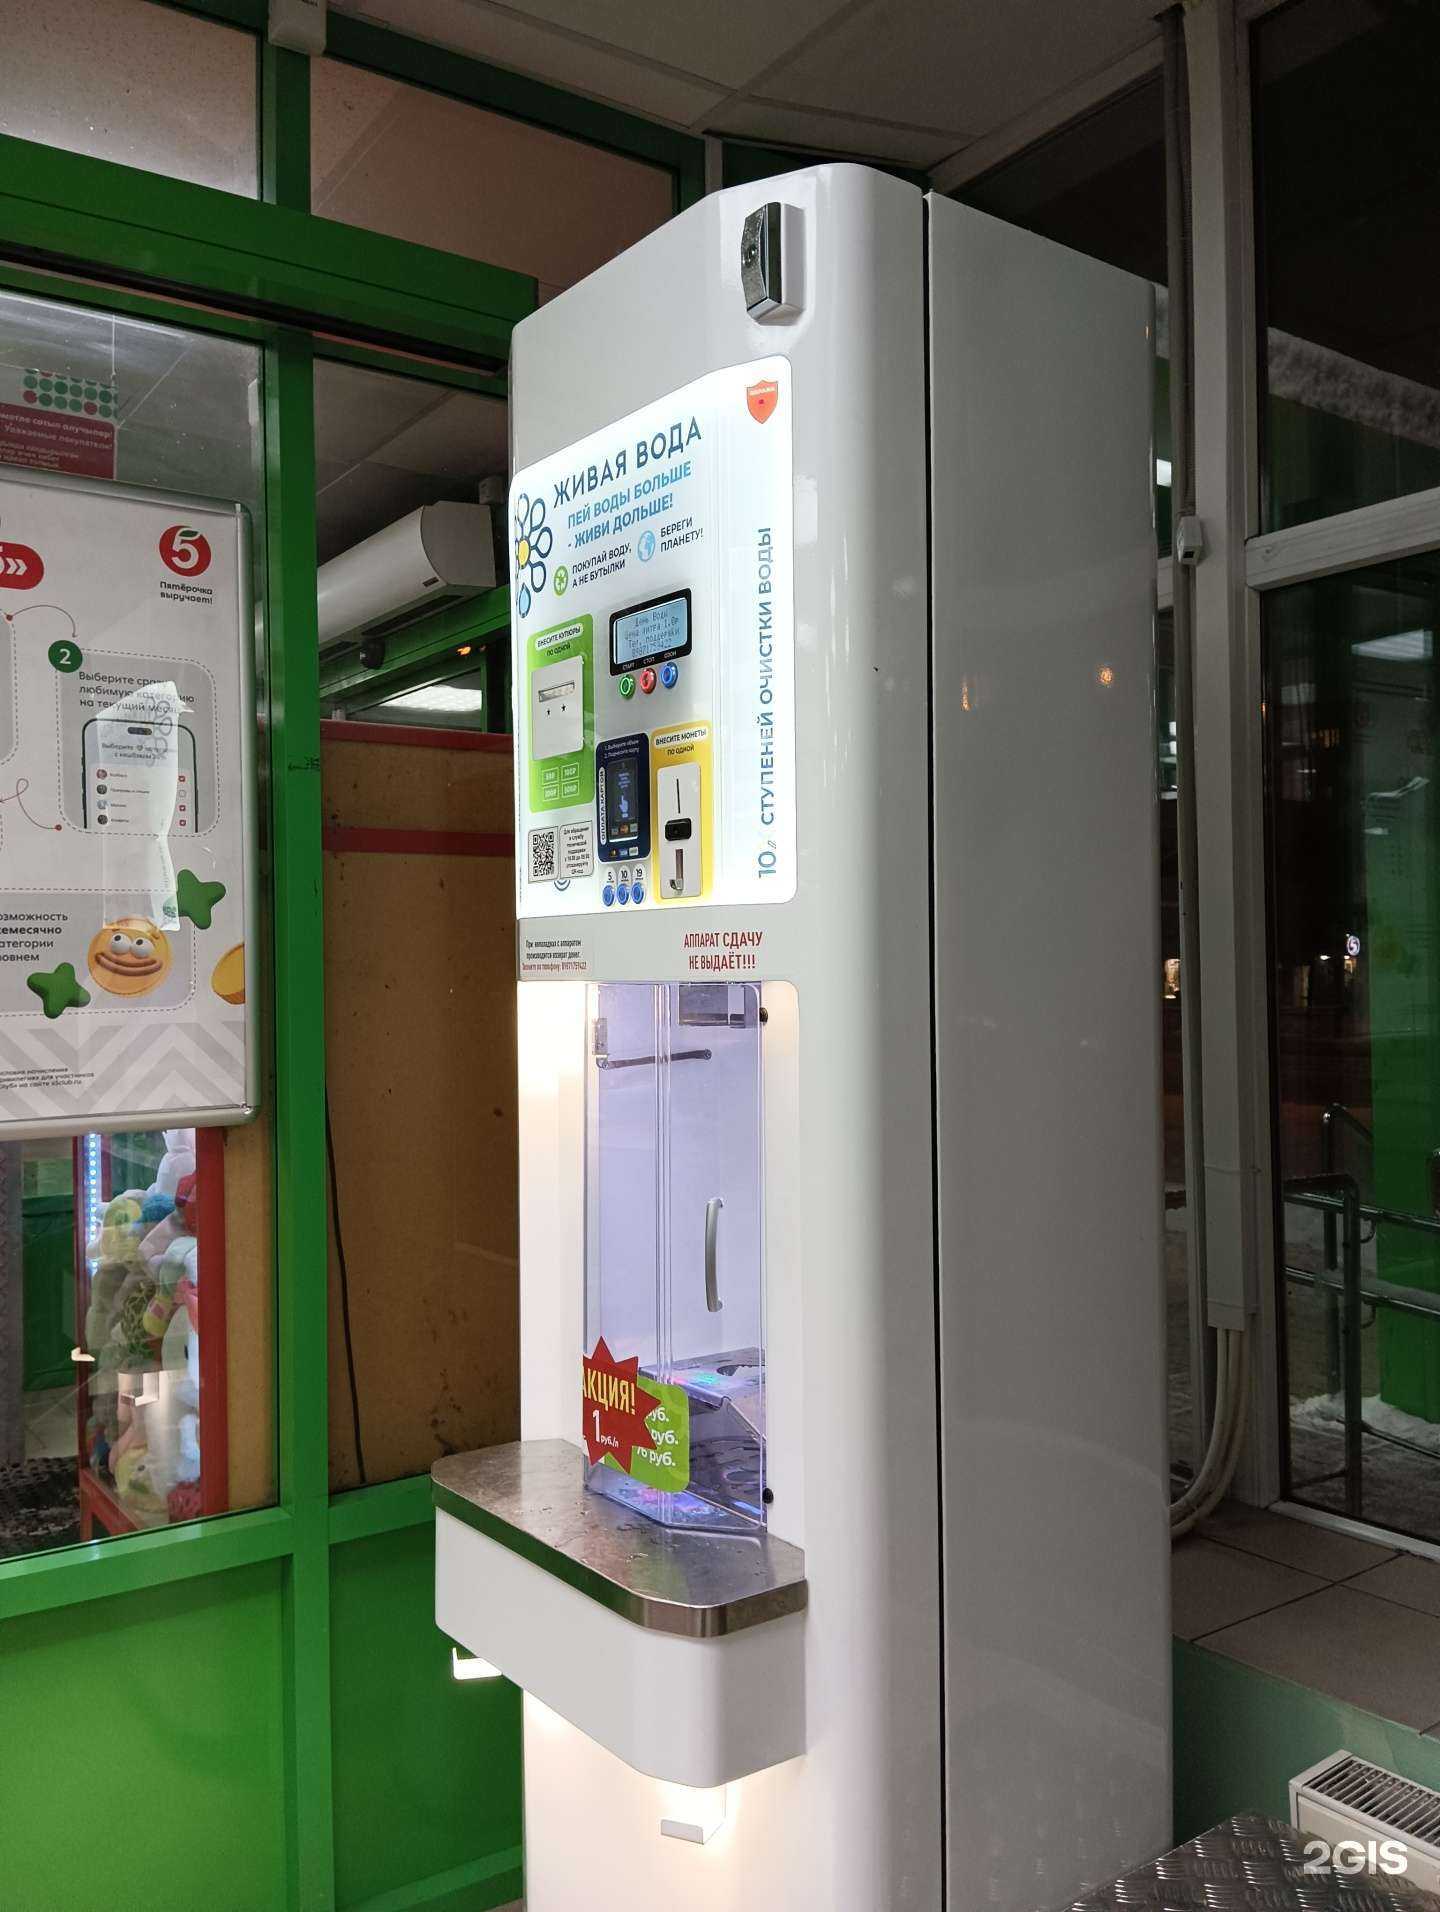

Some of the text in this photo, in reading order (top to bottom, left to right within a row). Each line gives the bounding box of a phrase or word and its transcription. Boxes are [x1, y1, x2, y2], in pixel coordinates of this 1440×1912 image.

[553, 415, 702, 508] ЖИВАЯ ВОДА
[568, 460, 691, 529] ПЕЙ ВОДЫ БОЛЬШЕ
[574, 520, 609, 548] ЖИВИ
[612, 493, 673, 535] ДОЛЬШЕ!
[660, 516, 693, 538] БЕРЕГИ
[660, 527, 704, 552] ПЛАНЕТУ!
[572, 542, 632, 575] ПОКУПАЙ ВОДУ,
[758, 527, 773, 594] ВОДЫ
[572, 558, 625, 588] А НЕ БУТЫЛКИ
[160, 581, 213, 595] Пятёрочка
[160, 591, 213, 605] выручает!
[58, 648, 72, 665] 2
[759, 601, 773, 704] ОЧИСТКИ
[79, 672, 135, 685] Выберите
[80, 699, 94, 707] на
[656, 728, 706, 745] ВНЕСИТЕ МОНЕТЫ
[667, 748, 675, 756] ПО
[757, 711, 774, 825] СТУПЕНЕЙ
[607, 871, 613, 881] 5
[620, 870, 628, 879] 10
[635, 868, 643, 877] 19
[0, 926, 62, 935] емесячно
[0, 940, 54, 949] атегории
[684, 931, 763, 949] АППАРАТ СДАЧУ
[689, 951, 755, 972] НЕ ВЫДАЁТ!!!
[592, 1409, 600, 1442] 1
[651, 1429, 678, 1445] руб.
[649, 1451, 676, 1467] руб.
